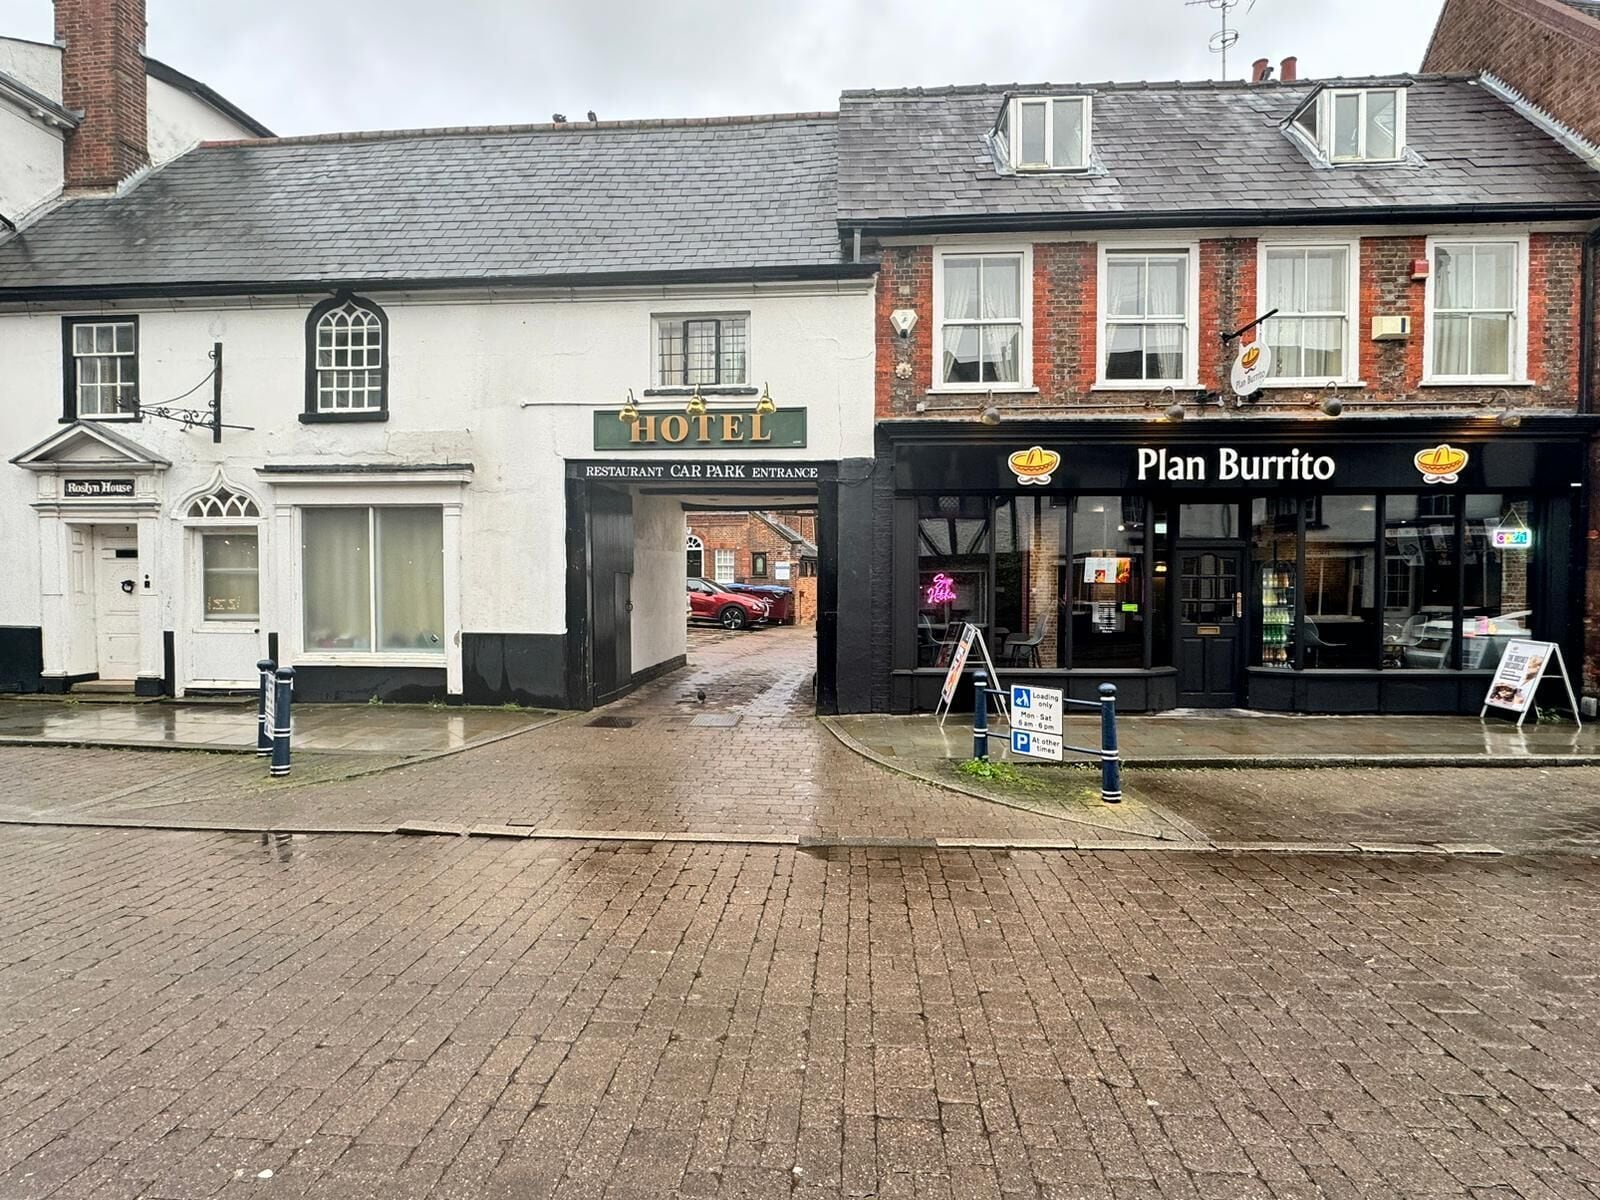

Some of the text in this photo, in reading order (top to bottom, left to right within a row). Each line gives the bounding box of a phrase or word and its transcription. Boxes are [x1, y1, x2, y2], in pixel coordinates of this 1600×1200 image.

[629, 413, 772, 443] HOTEL
[1137, 448, 1335, 480] Plan Burrito
[586, 464, 818, 478] RESTAURANT CAR PARK ENTRANCE
[68, 481, 132, 494] Roslyn House
[1033, 693, 1059, 702] Loading
[1040, 713, 1052, 721] Sat
[1017, 734, 1027, 749] P
[1042, 739, 1060, 747] other
[1036, 745, 1055, 754] times
